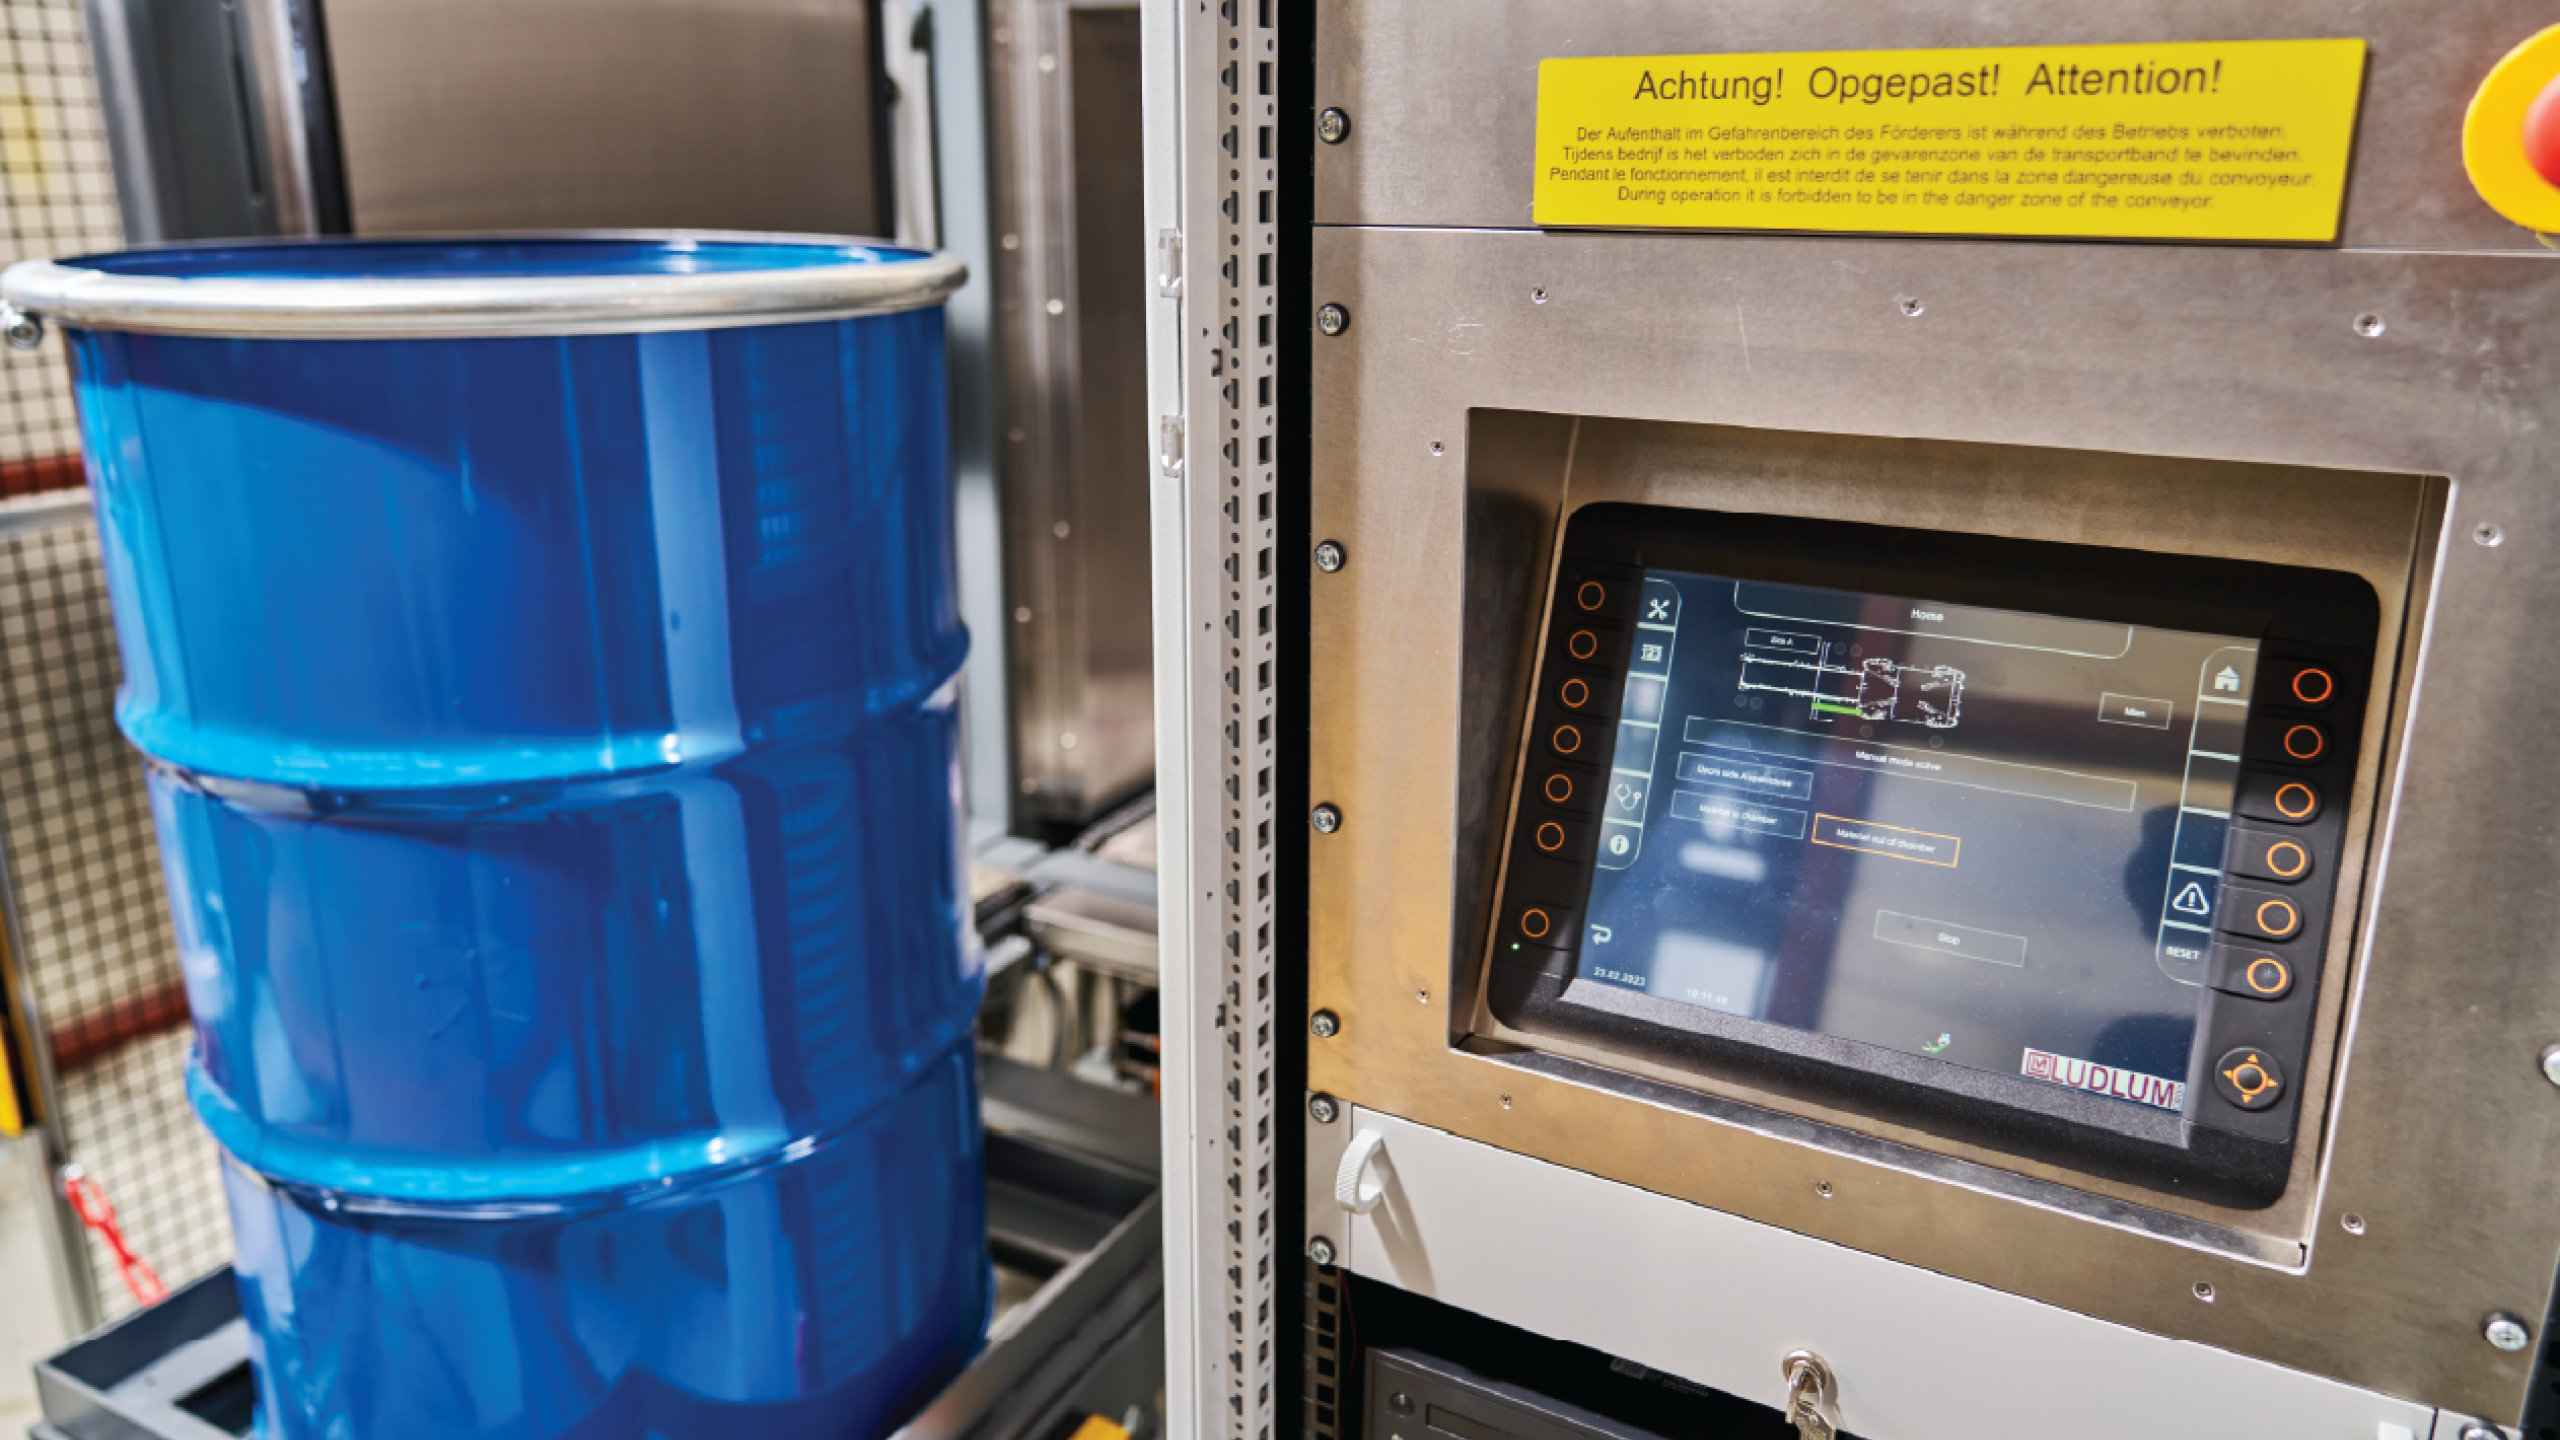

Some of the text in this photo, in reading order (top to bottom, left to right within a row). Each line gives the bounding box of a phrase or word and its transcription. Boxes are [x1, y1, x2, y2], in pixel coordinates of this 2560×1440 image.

[1633, 58, 2223, 107] Achtung! Opgepast! Attention!
[1576, 122, 2285, 142] Der Aufenthalt im Gefahrenbereich des Förderers ist während des Betriebs verboten.
[1562, 145, 2301, 166] Tijdens bedrijf is het verboden zich in de gevarenzone van de transportband te bevinden.
[1549, 167, 2316, 191] Pendant le fonctionnement, il est interdit de se tenir dans la zone dangereuse du convoyeur.
[1617, 185, 2216, 212] During operation it is forbidden to be in the danger zone of the conveyor.
[1911, 608, 1945, 622] Home
[1855, 750, 1942, 771] Manual mode active
[1699, 804, 1731, 818] Material
[1836, 828, 1936, 853] Material out of chamber
[1938, 931, 1962, 945] Stop
[2166, 946, 2201, 961] RESET
[2051, 1055, 2176, 1108] LUDLUM
